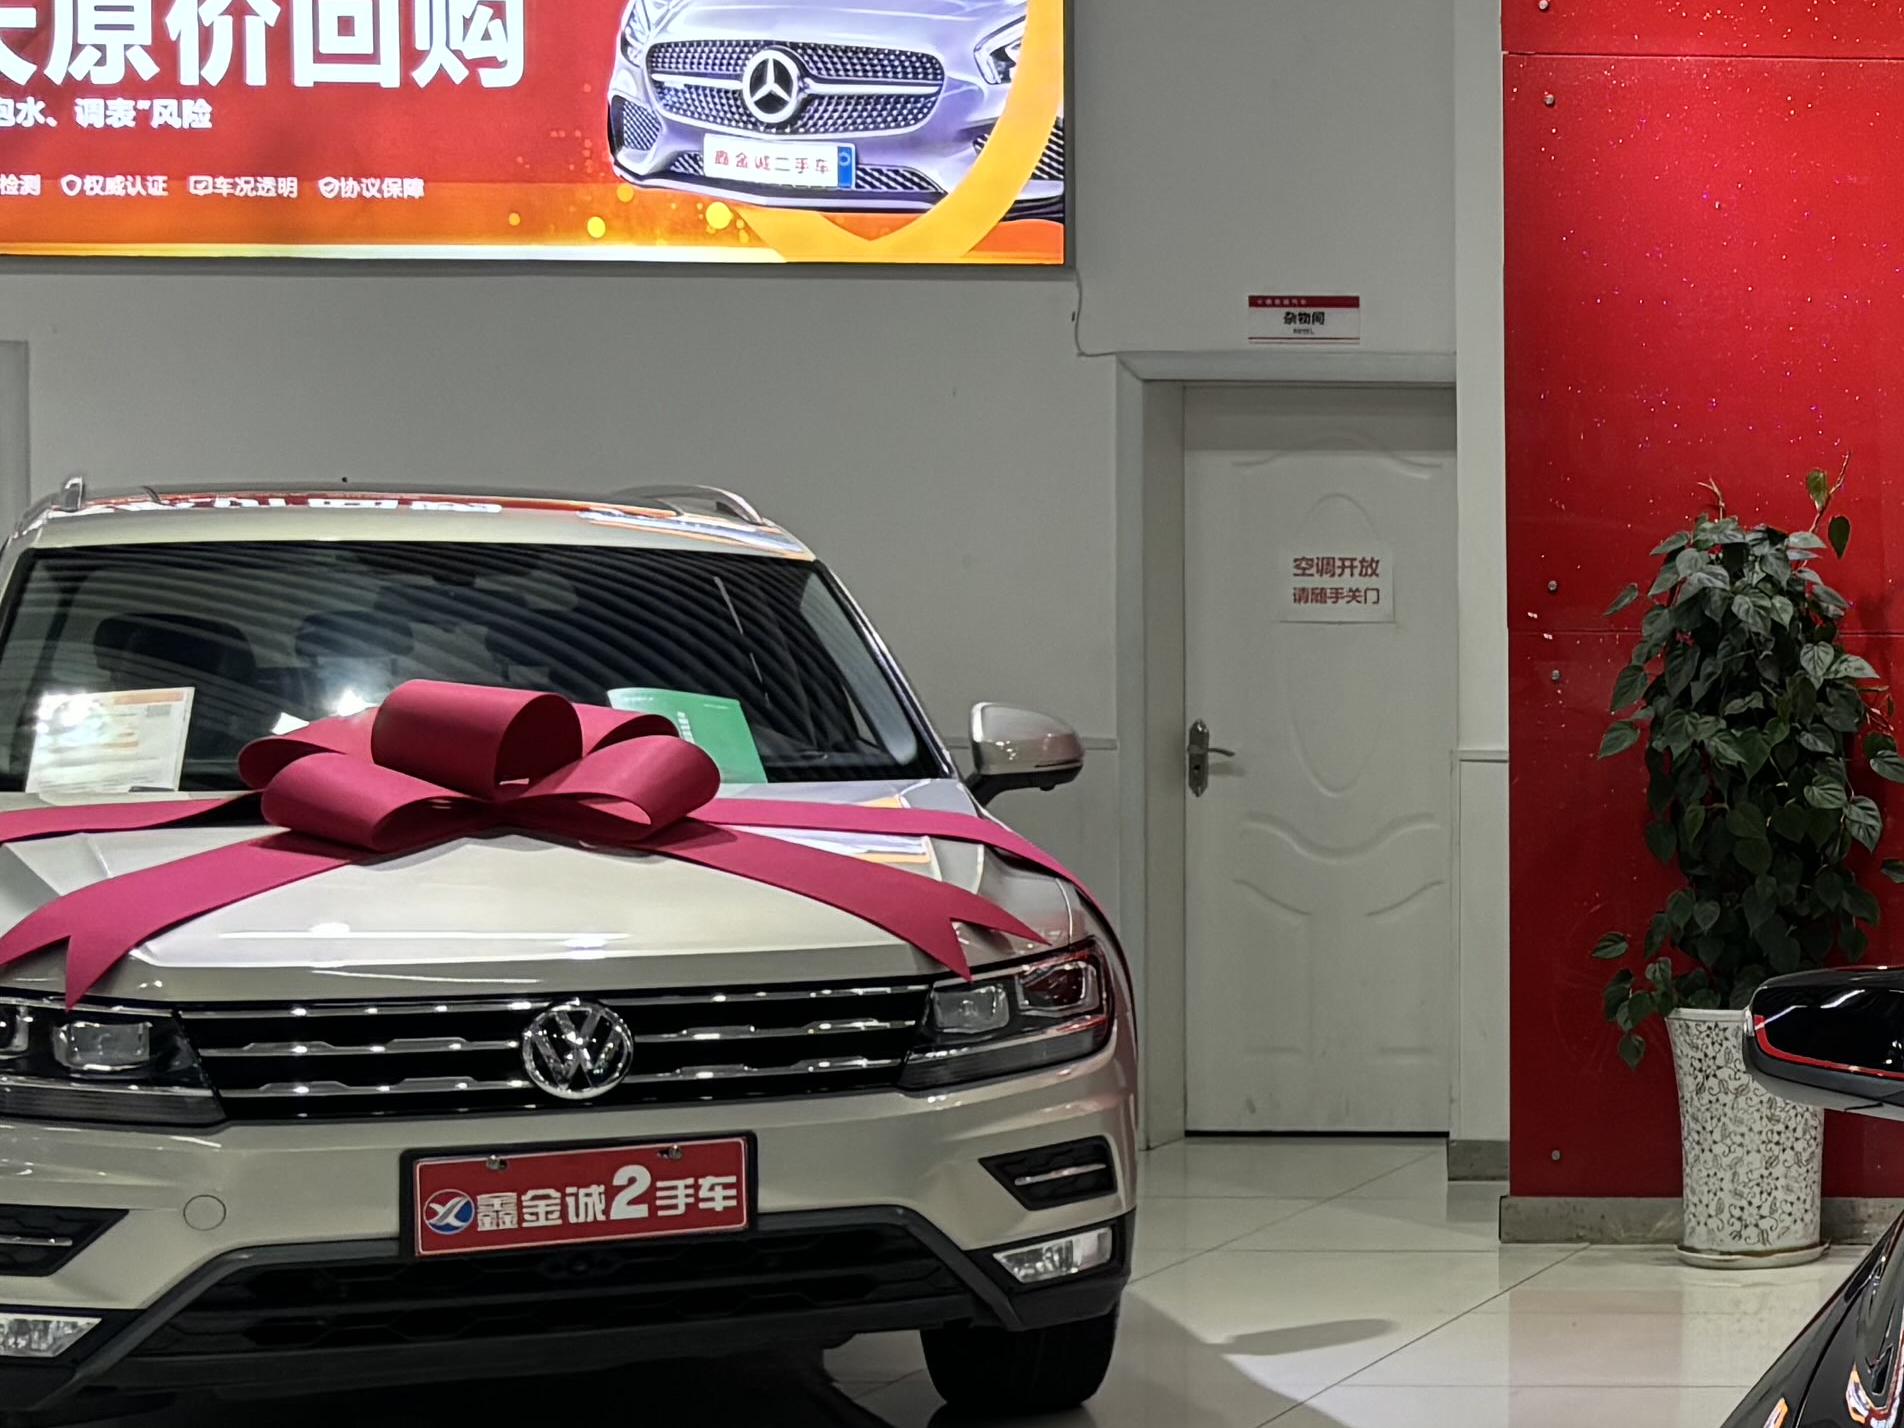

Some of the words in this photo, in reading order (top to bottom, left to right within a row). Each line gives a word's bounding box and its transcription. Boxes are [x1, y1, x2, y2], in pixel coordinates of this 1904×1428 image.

[84, 175, 168, 197] 权威认证
[213, 176, 298, 198] 车况透明
[340, 177, 424, 199] 协议保障
[1293, 556, 1380, 578] 空调开放
[1293, 587, 1380, 604] 请随手关门
[476, 1164, 738, 1232] 鑫金诚2手车
